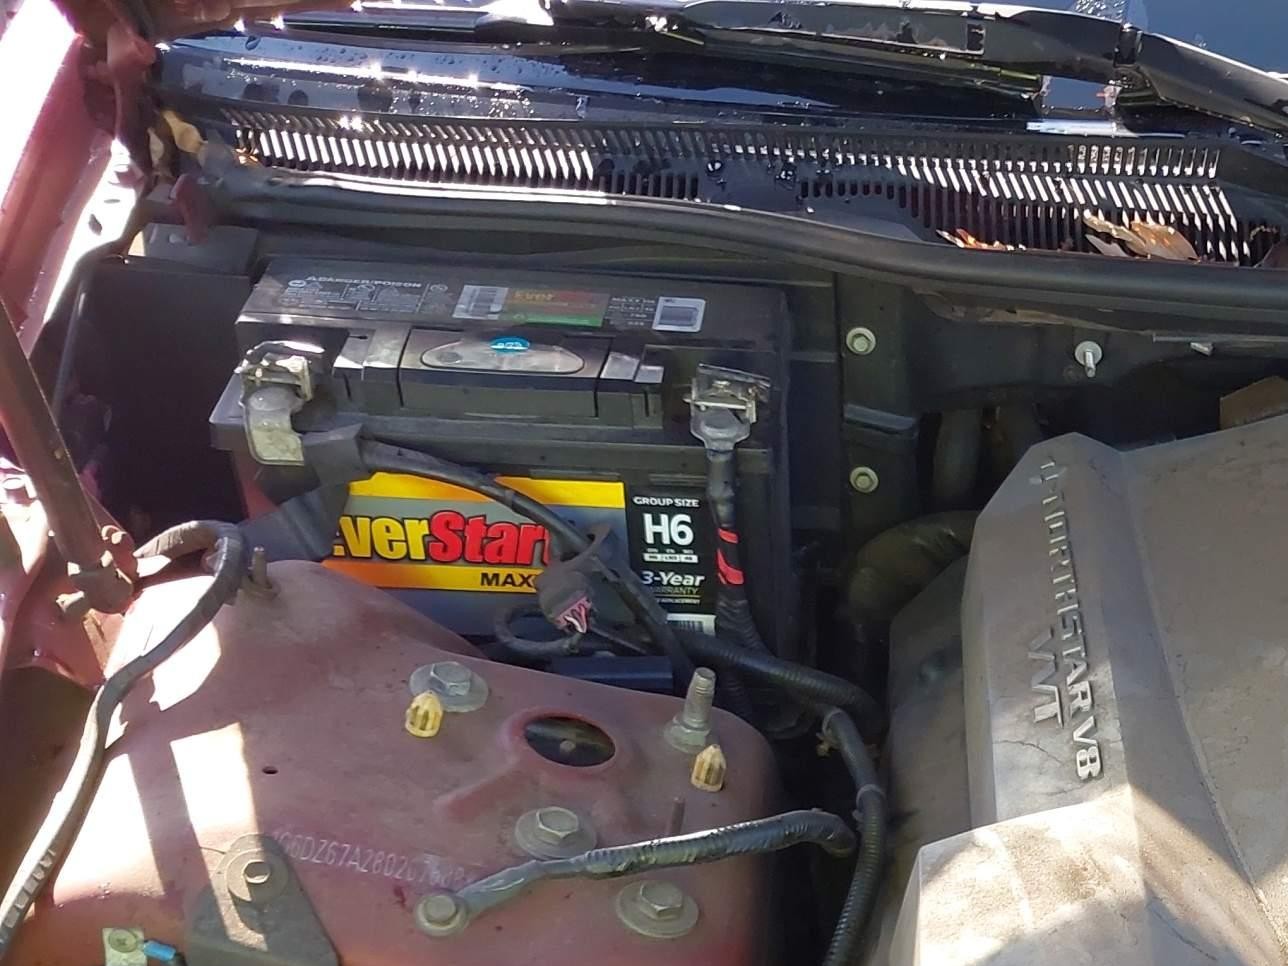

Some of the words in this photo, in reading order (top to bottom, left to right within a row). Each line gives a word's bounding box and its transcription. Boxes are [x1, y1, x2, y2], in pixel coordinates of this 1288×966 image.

[633, 495, 674, 506] GROUP
[675, 498, 700, 508] SIZE
[643, 513, 695, 546] H6
[642, 570, 705, 587] 3-Year
[1073, 715, 1103, 781] V8
